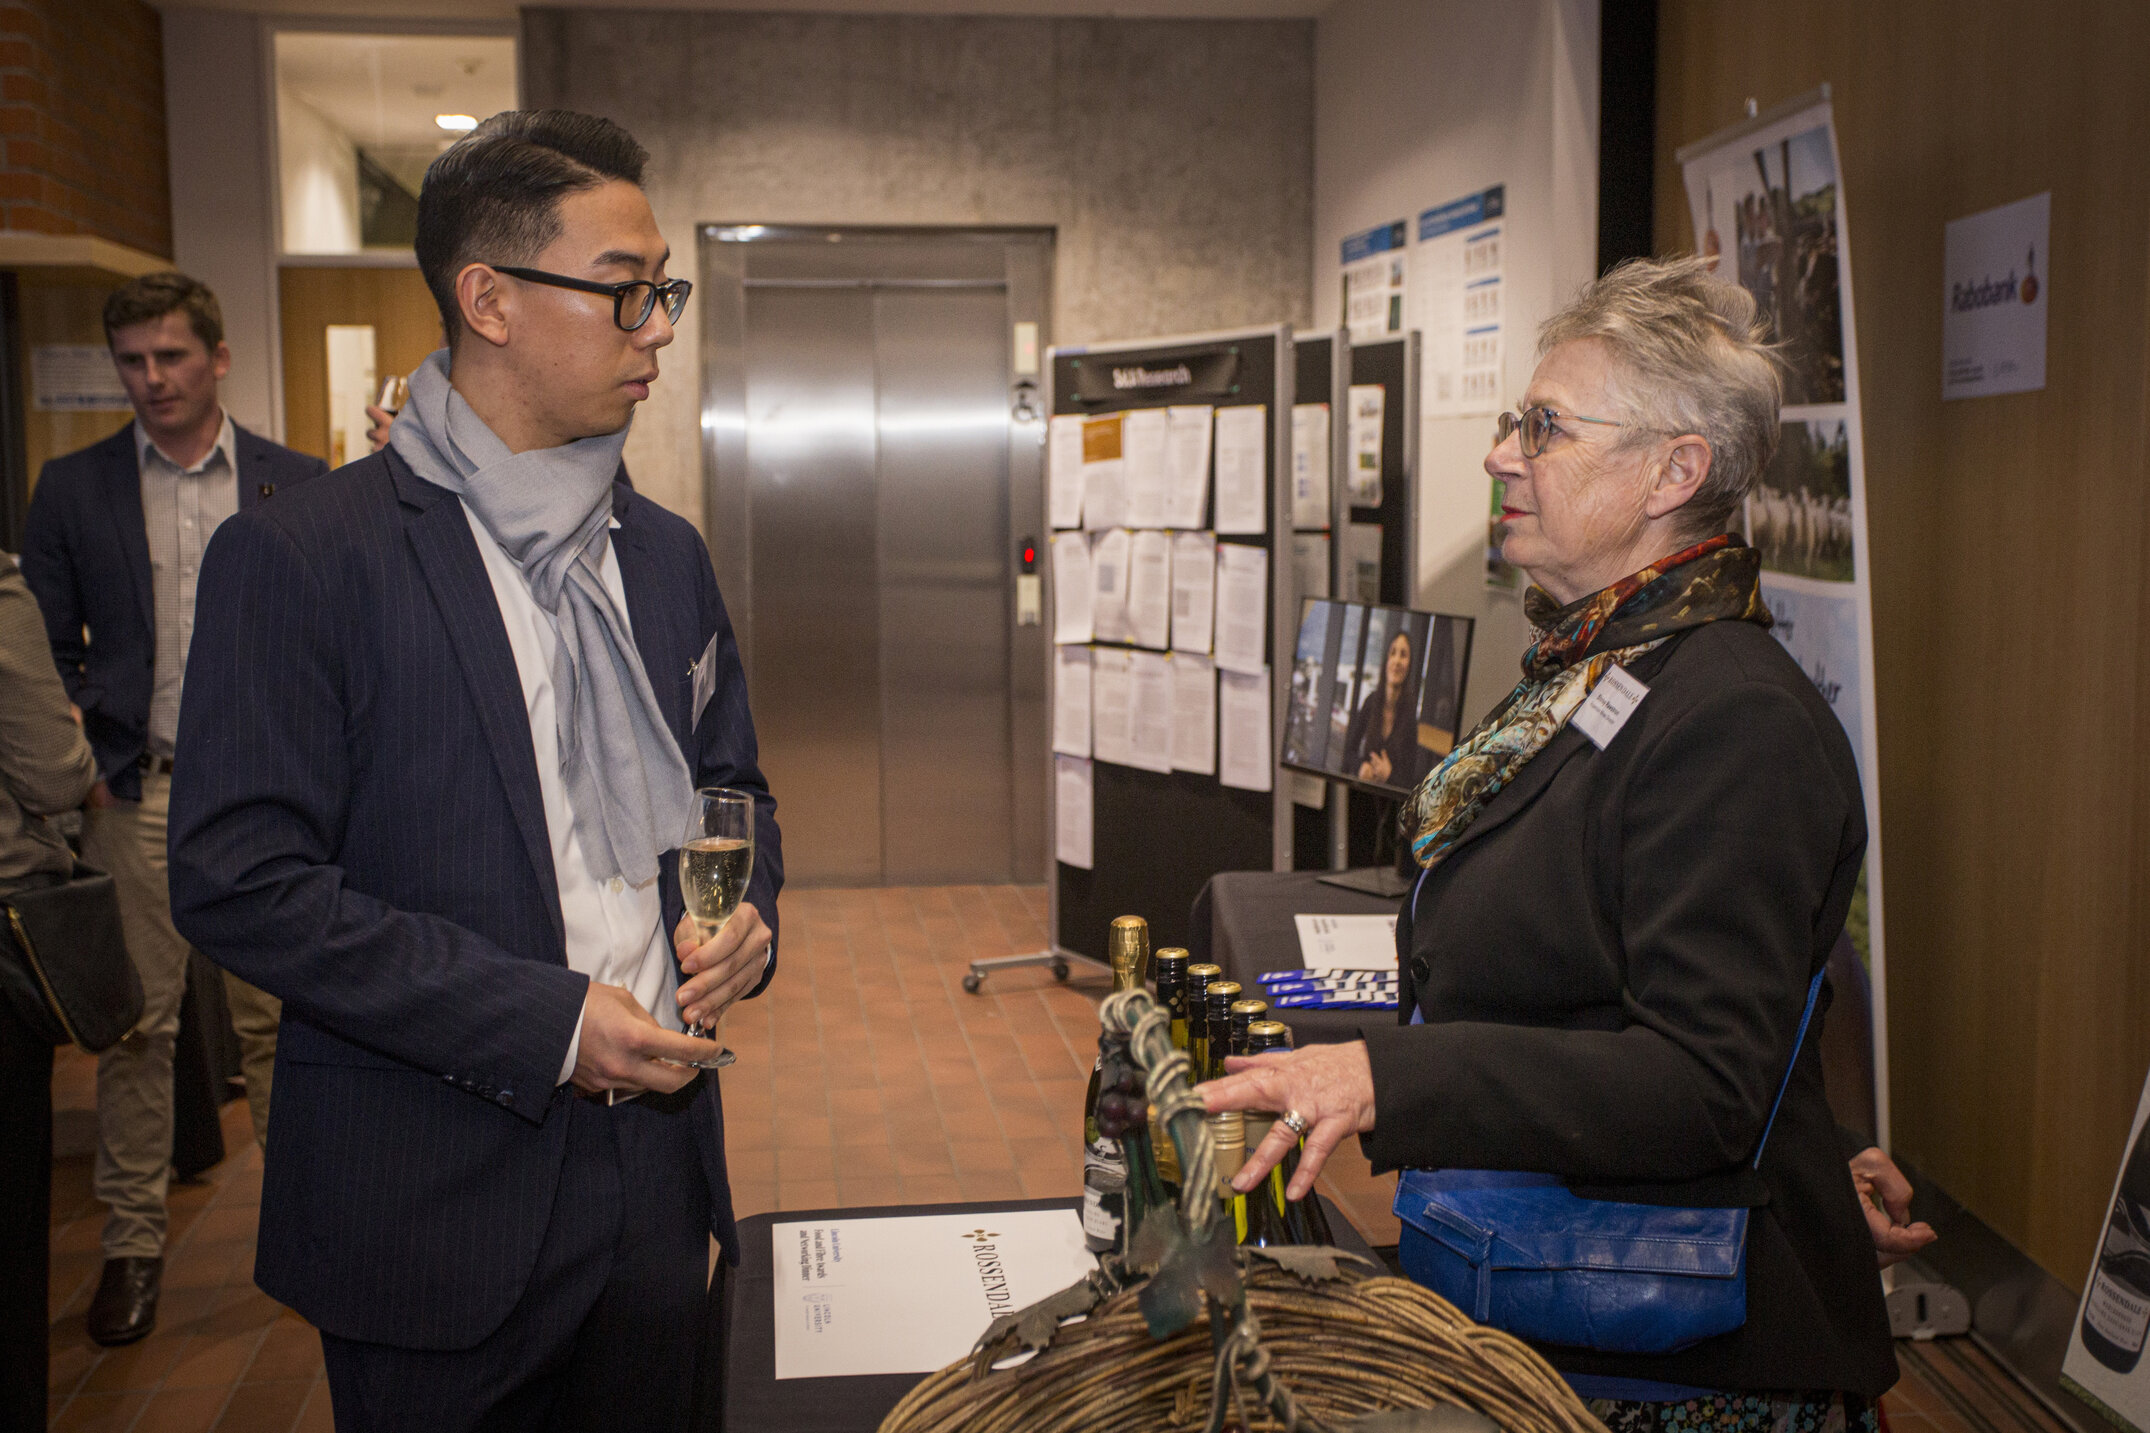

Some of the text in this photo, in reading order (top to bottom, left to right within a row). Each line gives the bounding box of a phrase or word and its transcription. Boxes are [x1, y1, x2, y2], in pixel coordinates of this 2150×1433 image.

[1951, 268, 2017, 312] Rabobank
[814, 1229, 824, 1240] Food
[815, 1240, 825, 1249] and
[830, 1228, 843, 1263] Lincoln University
[799, 1230, 813, 1281] and Networking Dinner
[816, 1249, 826, 1261] Fibre
[973, 1244, 1015, 1319] ROSSENDAL
[2101, 1282, 2141, 1315] ROSSENDALE
[813, 1304, 823, 1333] UNIVERSITY
